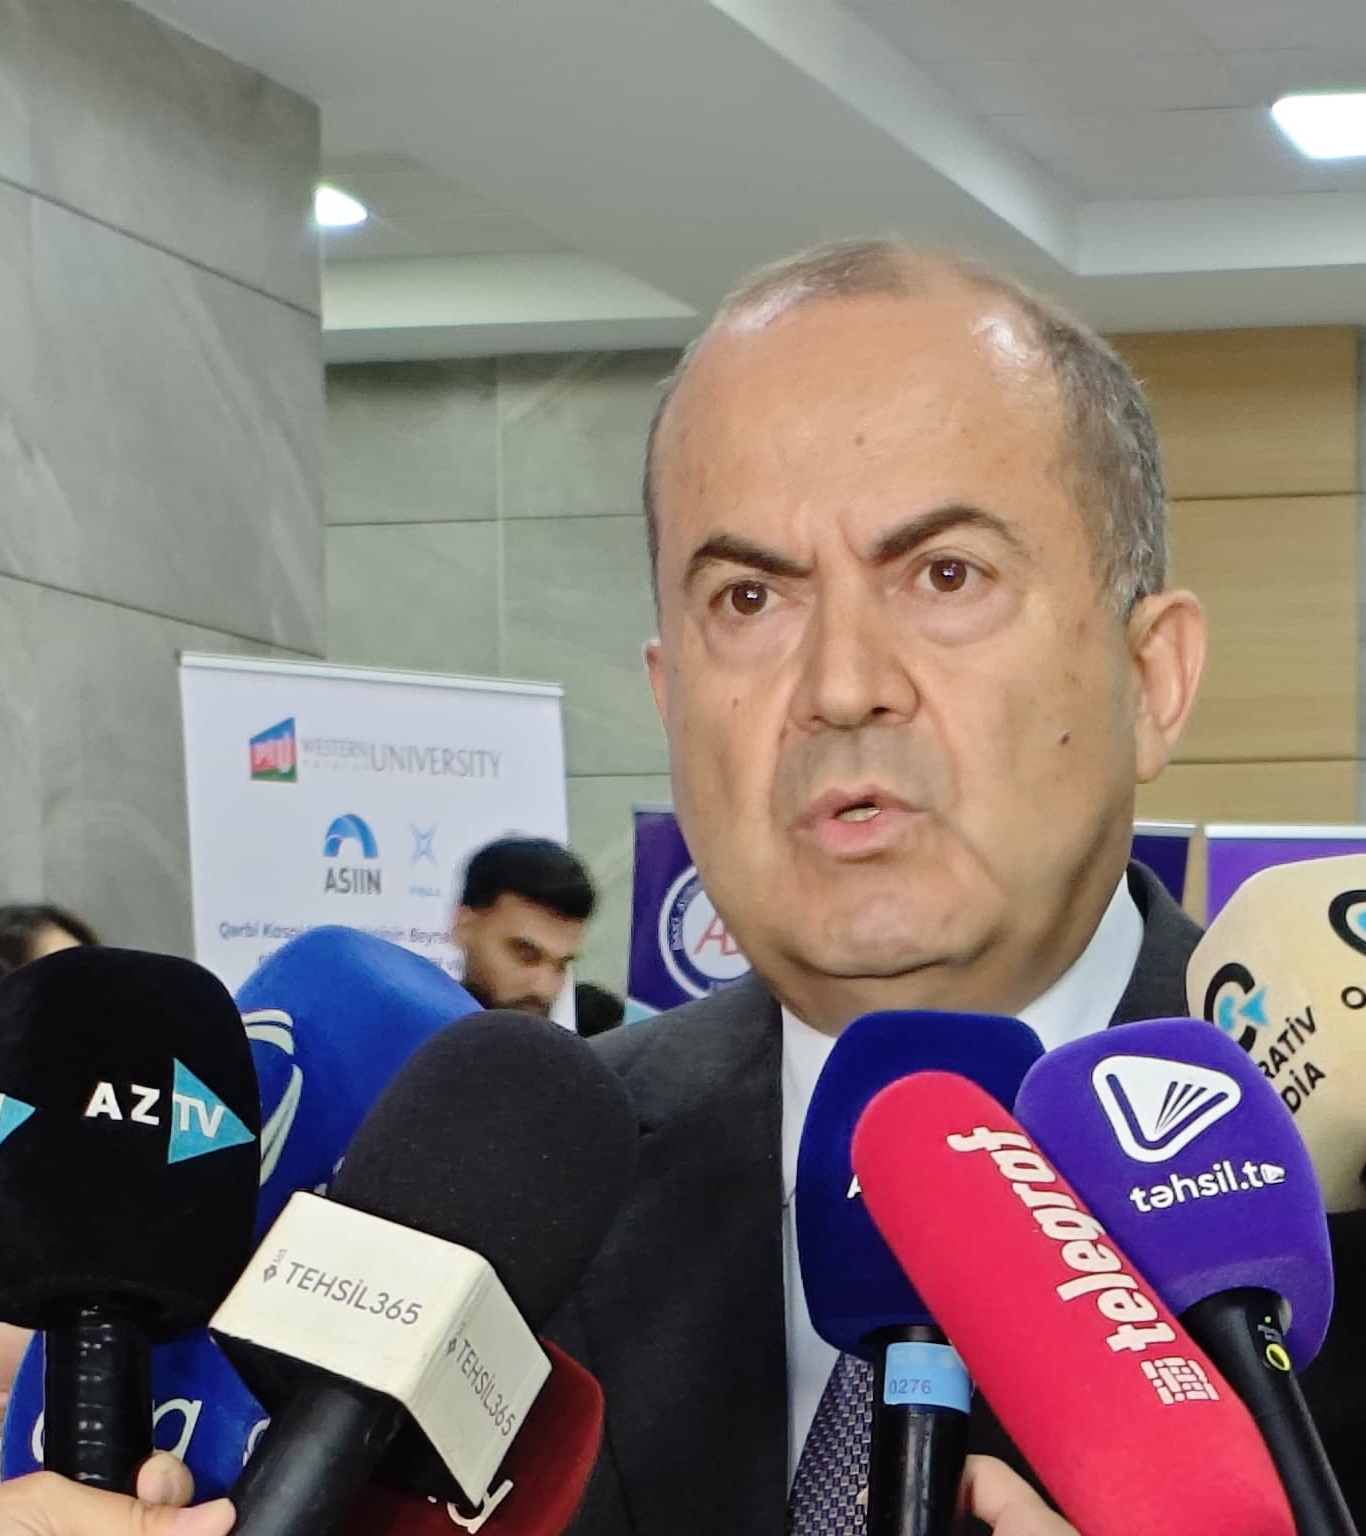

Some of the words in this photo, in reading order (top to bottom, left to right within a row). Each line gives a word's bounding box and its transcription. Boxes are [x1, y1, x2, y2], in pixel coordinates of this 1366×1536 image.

[370, 743, 502, 778] UNIVERSITY
[324, 868, 382, 896] ASIIN
[286, 1261, 422, 1325] TEHSİL365
[456, 1339, 516, 1436] TEHSİL365
[889, 1379, 932, 1395] 0276
